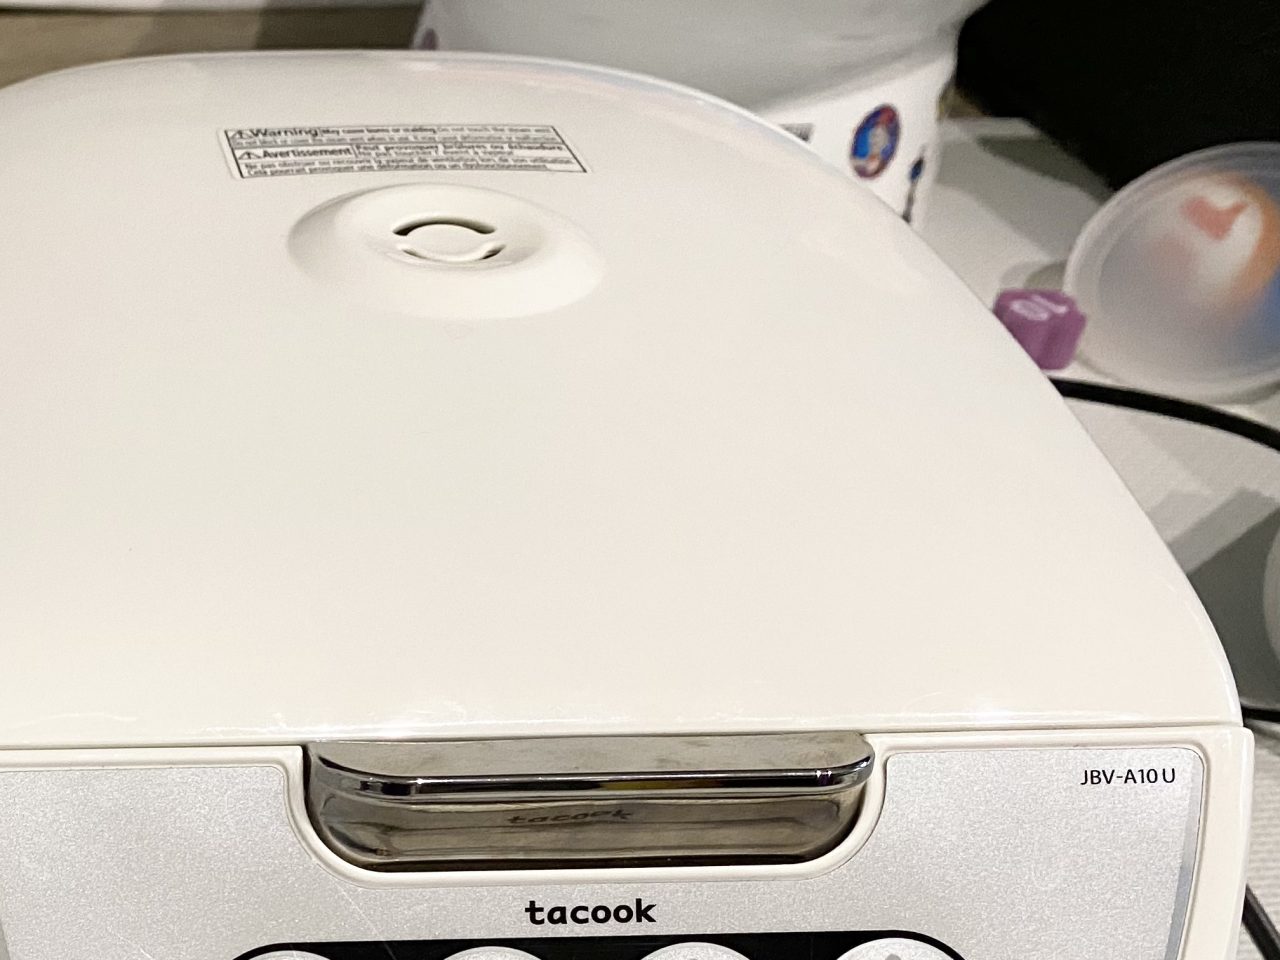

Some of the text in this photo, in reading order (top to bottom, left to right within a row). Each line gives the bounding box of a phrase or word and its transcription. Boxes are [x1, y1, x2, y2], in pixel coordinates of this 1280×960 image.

[248, 127, 318, 138] Warning
[263, 147, 352, 158] Avertissement
[525, 898, 657, 925] tacook
